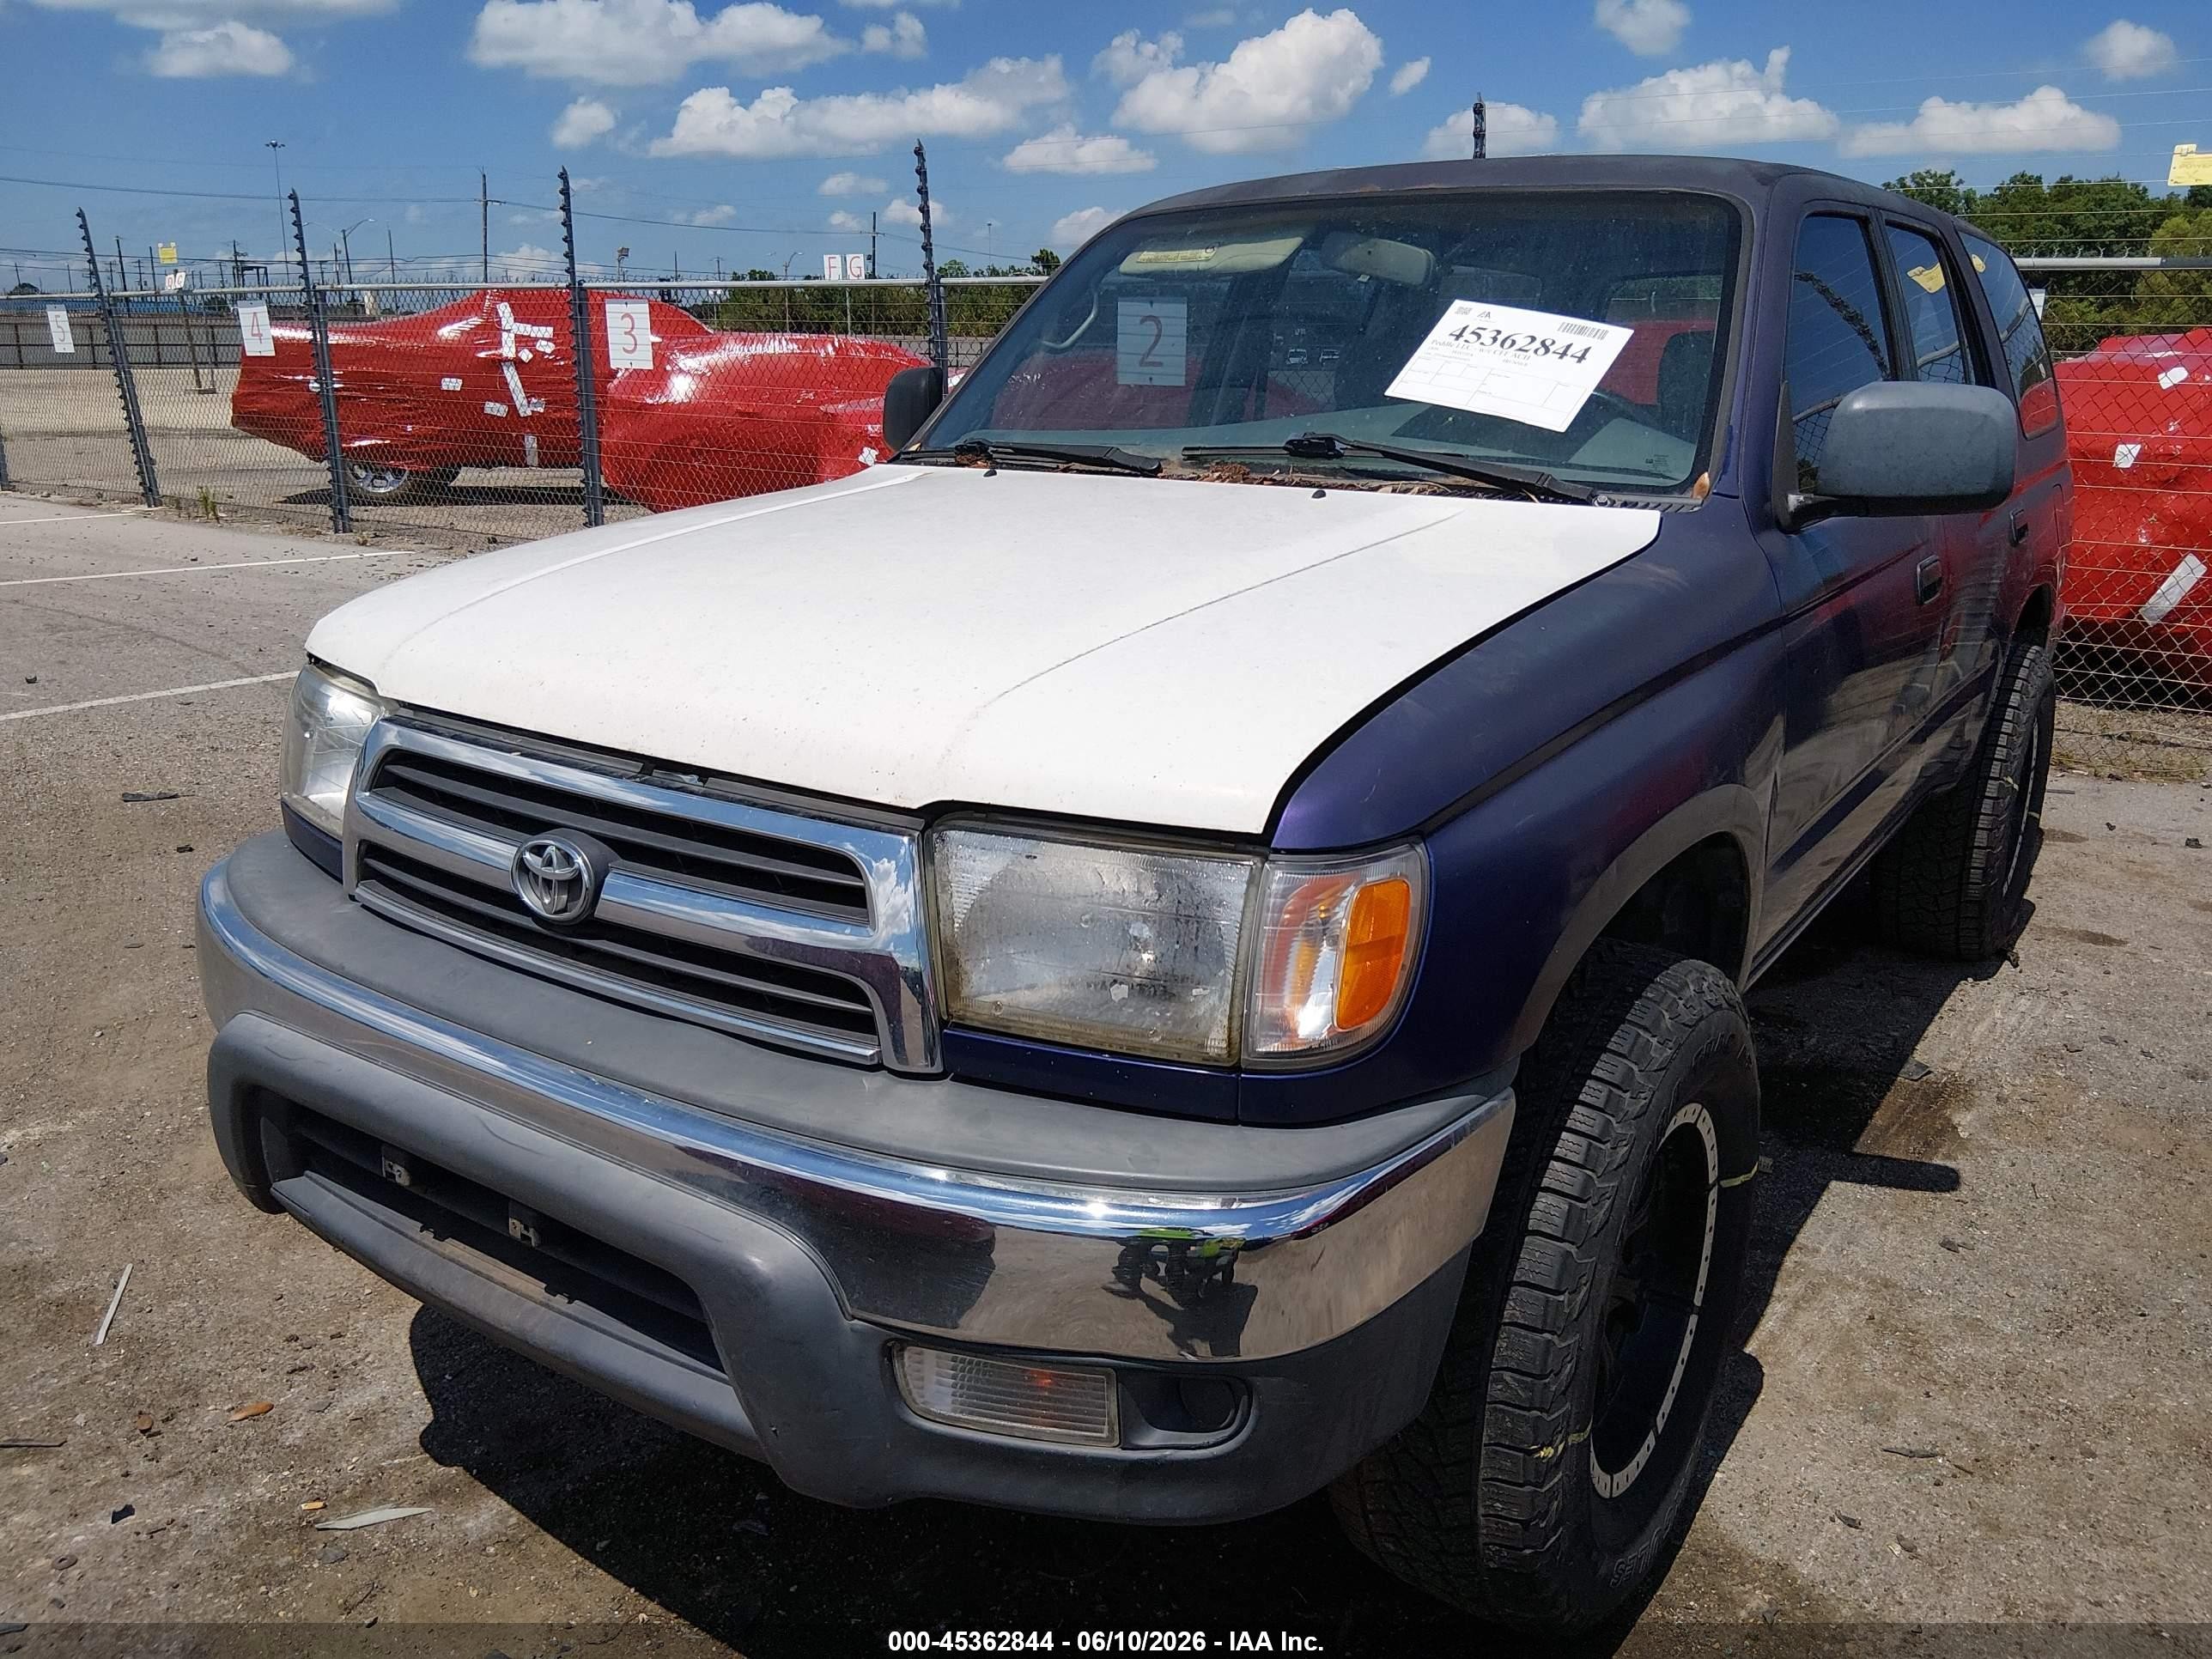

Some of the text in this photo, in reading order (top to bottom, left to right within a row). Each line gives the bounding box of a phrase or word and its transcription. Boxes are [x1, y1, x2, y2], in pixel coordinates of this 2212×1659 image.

[827, 256, 863, 279] F G
[53, 314, 66, 343] 5
[250, 312, 264, 344] 4
[620, 313, 638, 355] 3
[1139, 314, 1164, 368] 2
[1448, 324, 1592, 365] 45362844
